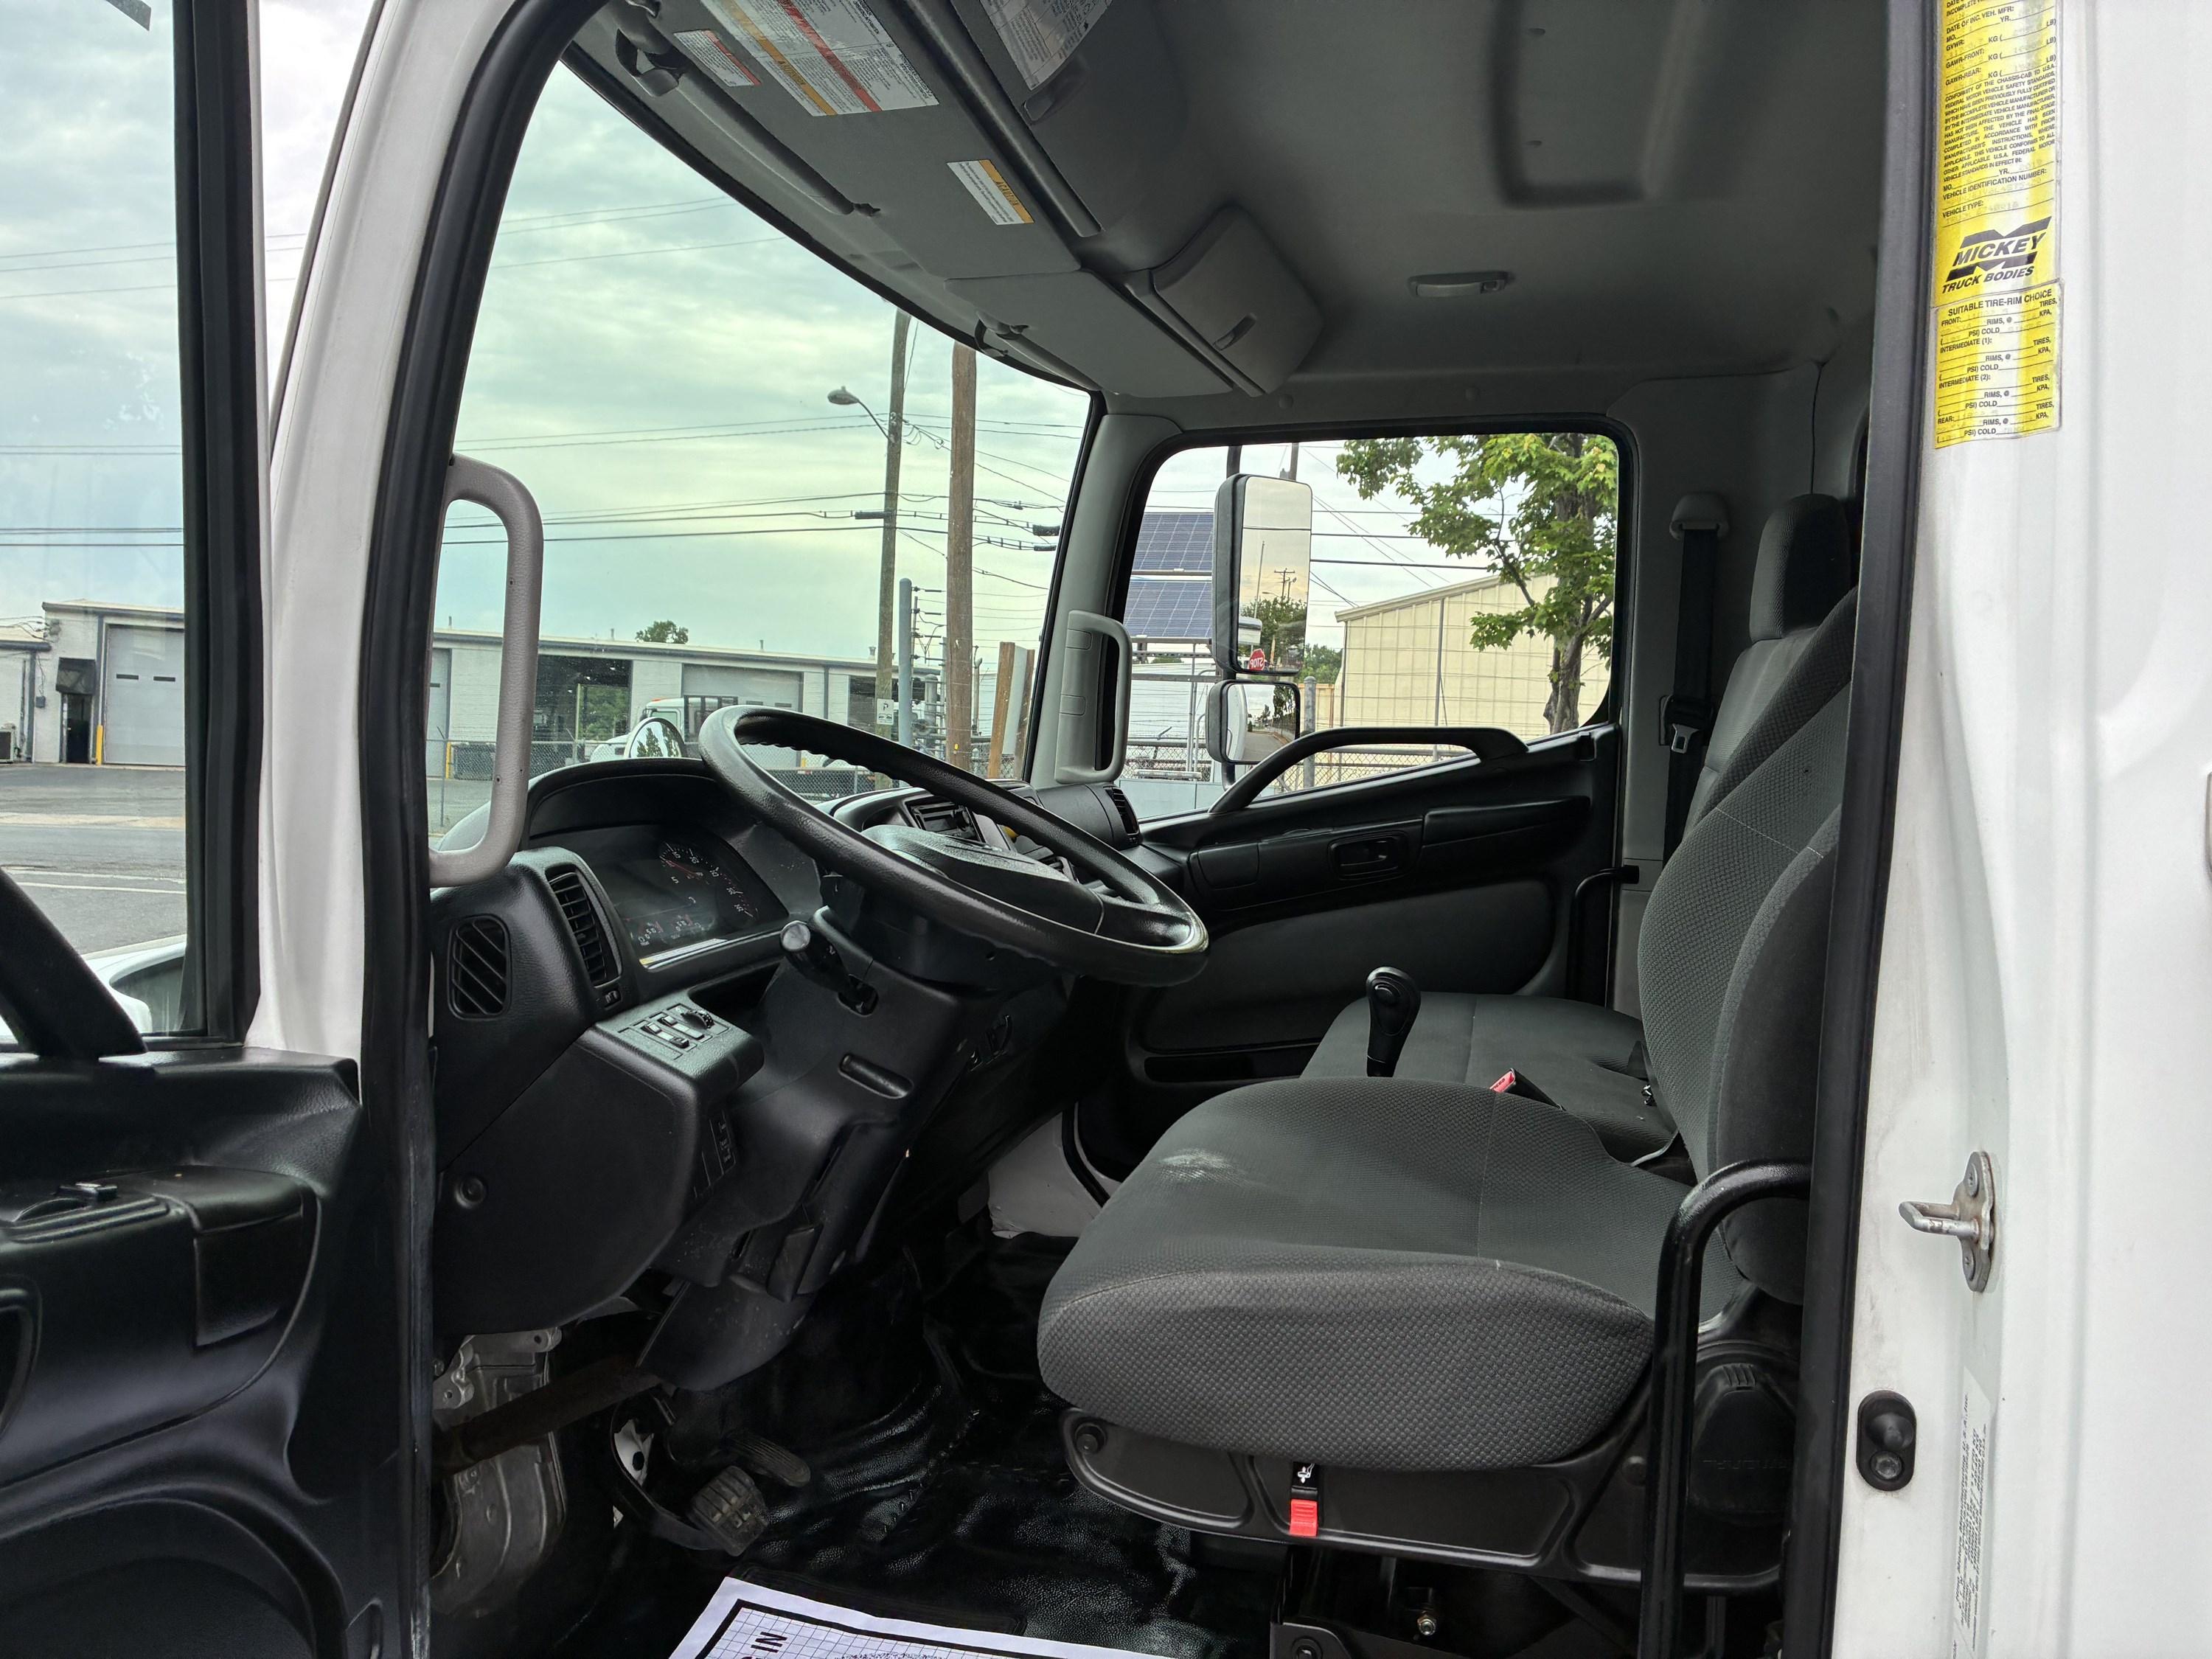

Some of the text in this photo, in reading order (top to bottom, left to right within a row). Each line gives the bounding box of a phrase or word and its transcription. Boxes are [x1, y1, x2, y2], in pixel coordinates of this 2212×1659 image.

[1947, 23, 1961, 34] DATE
[1981, 9, 1997, 18] VEH.
[1997, 5, 2014, 15] MFR:
[1947, 38, 1965, 51] GVWR:
[1947, 48, 1984, 69] GAWR-FRONT:
[1946, 67, 1981, 86] GAWR-REAR:
[1983, 85, 2004, 95] VEHICLE
[2006, 80, 2025, 89] SAFETY
[1994, 105, 2015, 114] VEHICLE
[1978, 114, 2004, 126] AFFECTED
[1999, 119, 2023, 129] VEHICLE
[1983, 126, 2021, 139] ACCORDANCE
[1986, 145, 2008, 153] VEHICLE
[1943, 187, 1967, 201] VEHICLE
[1968, 175, 2017, 192] IDENTIFICATION
[2019, 167, 2046, 181] NUMBER:
[1943, 206, 1966, 219] VEHICLE
[1966, 199, 1983, 211] TYPE:
[1952, 232, 2046, 267] MICKEY
[1942, 265, 2034, 293] TRUCK BODIES
[1948, 288, 2052, 316] SUITABLE TIRE-RIM CHOICE
[2039, 297, 2057, 307] TIRES,
[1986, 316, 2005, 326] RIMS,
[1981, 327, 2000, 335] COLD
[1941, 338, 1980, 353] INTERMEDIATE
[2034, 336, 2051, 346] TIRES,
[1986, 354, 2003, 362] RIMS,
[1939, 375, 1980, 389] INTERMEDIATE
[2032, 374, 2050, 383] TIRES,
[1984, 390, 2002, 398] RIMS,
[1938, 401, 2054, 425] REAR: TIRES,
